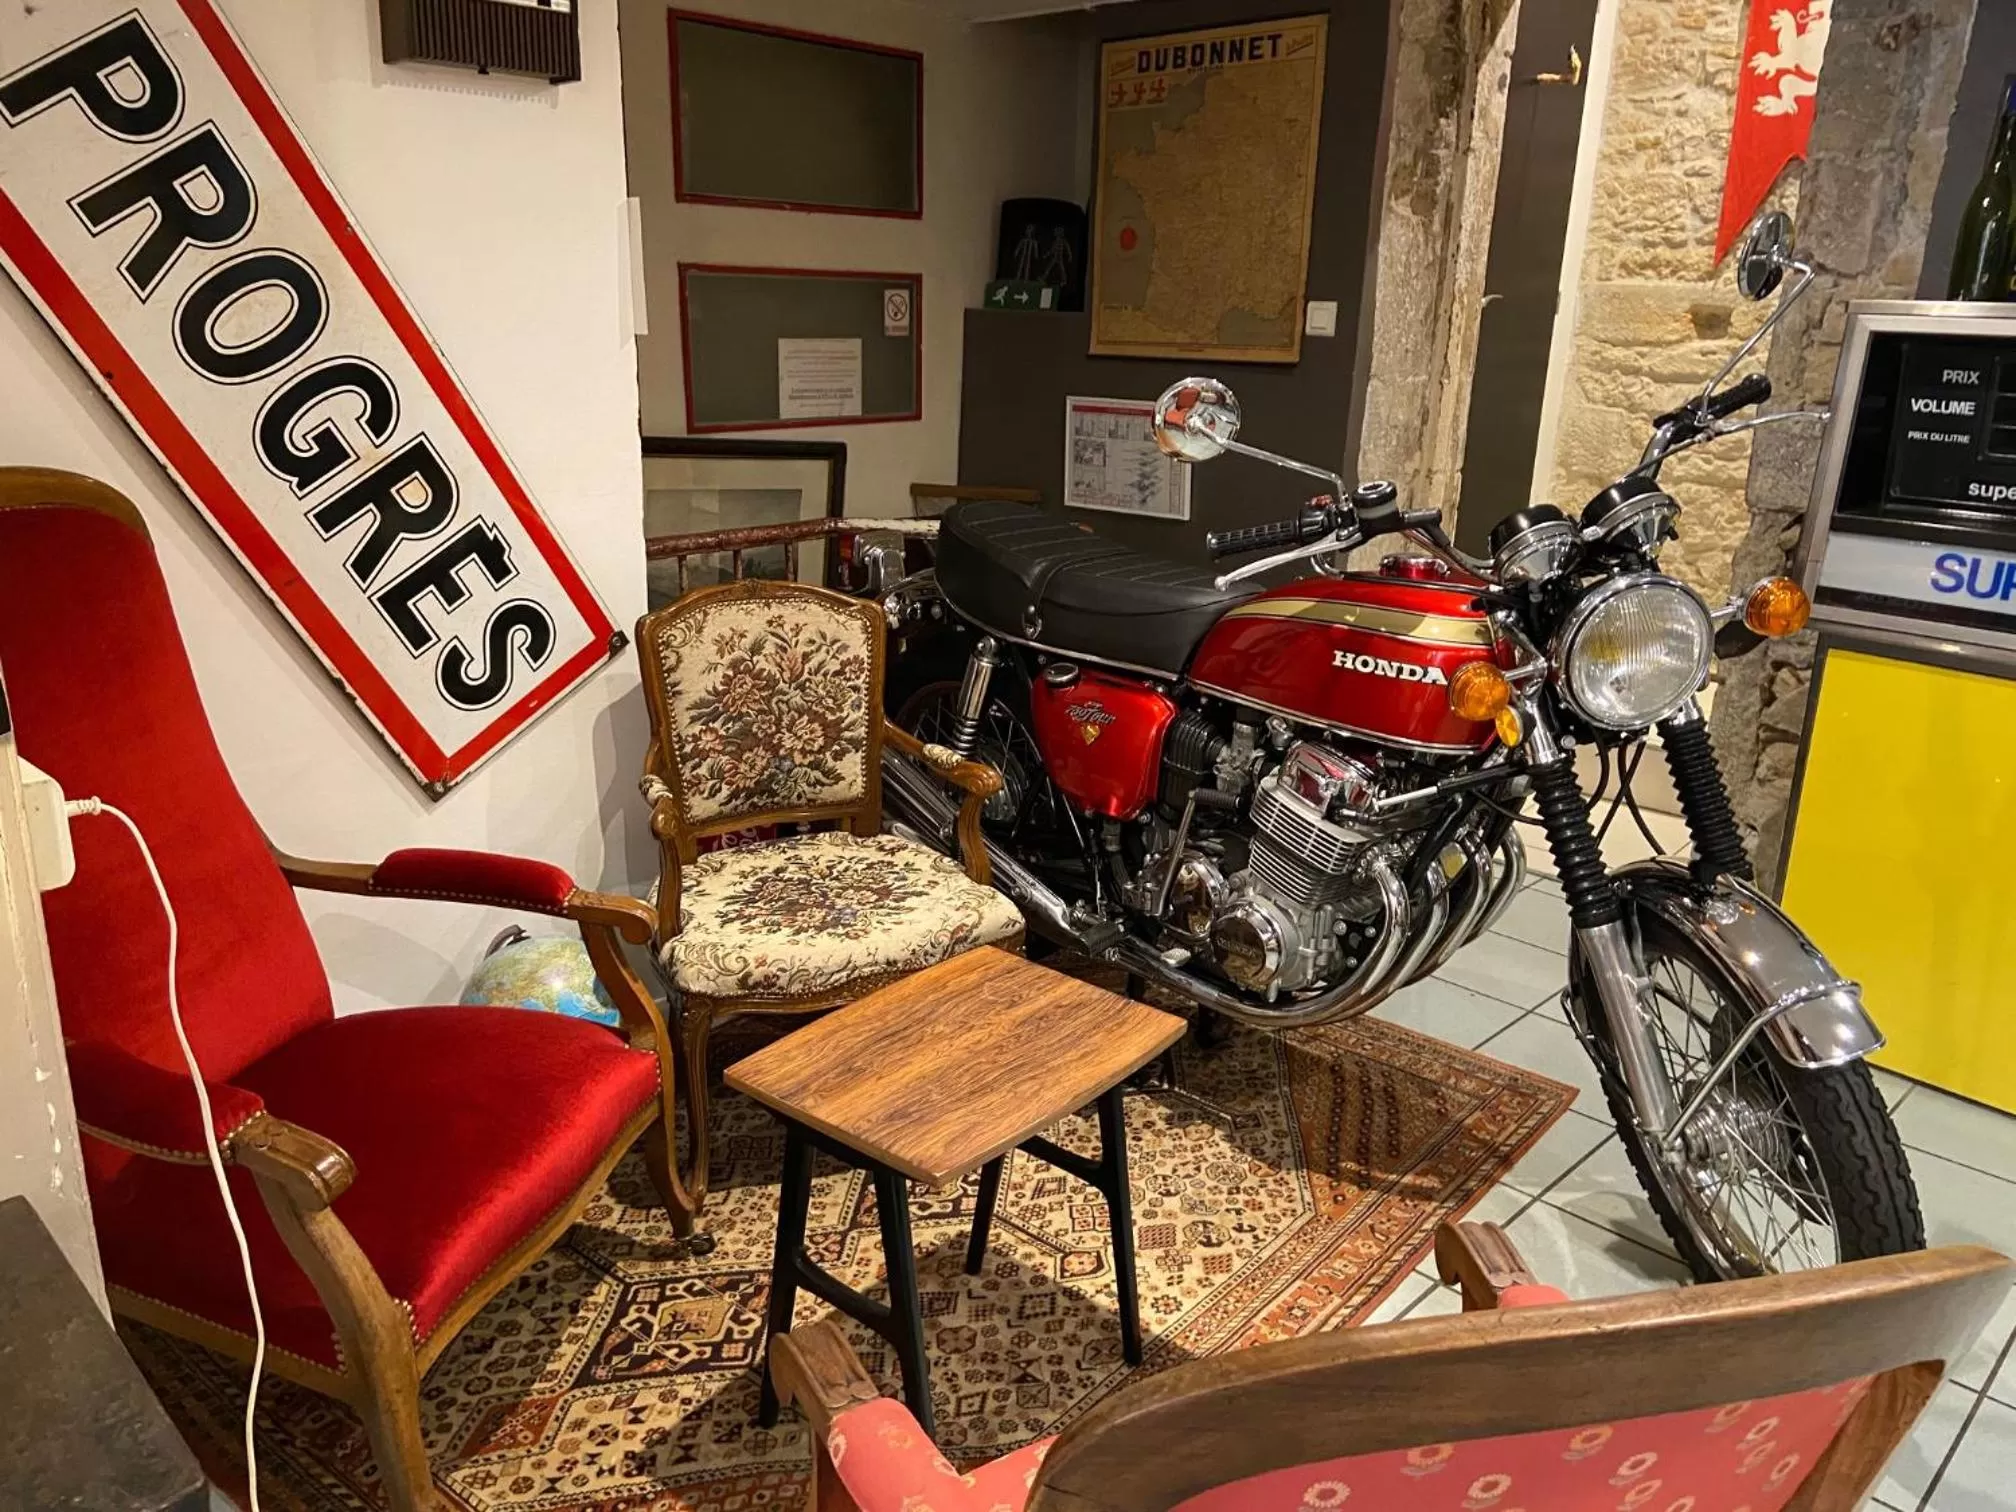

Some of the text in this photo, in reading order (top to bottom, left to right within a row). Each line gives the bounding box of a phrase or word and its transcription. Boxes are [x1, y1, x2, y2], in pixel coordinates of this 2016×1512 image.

[1136, 33, 1283, 74] DUBONNET
[1942, 369, 1980, 385] PRIX
[1910, 397, 1977, 416] VOLUME
[1907, 430, 1971, 444] PRIX DU LITRE
[1332, 650, 1448, 686] HONDA
